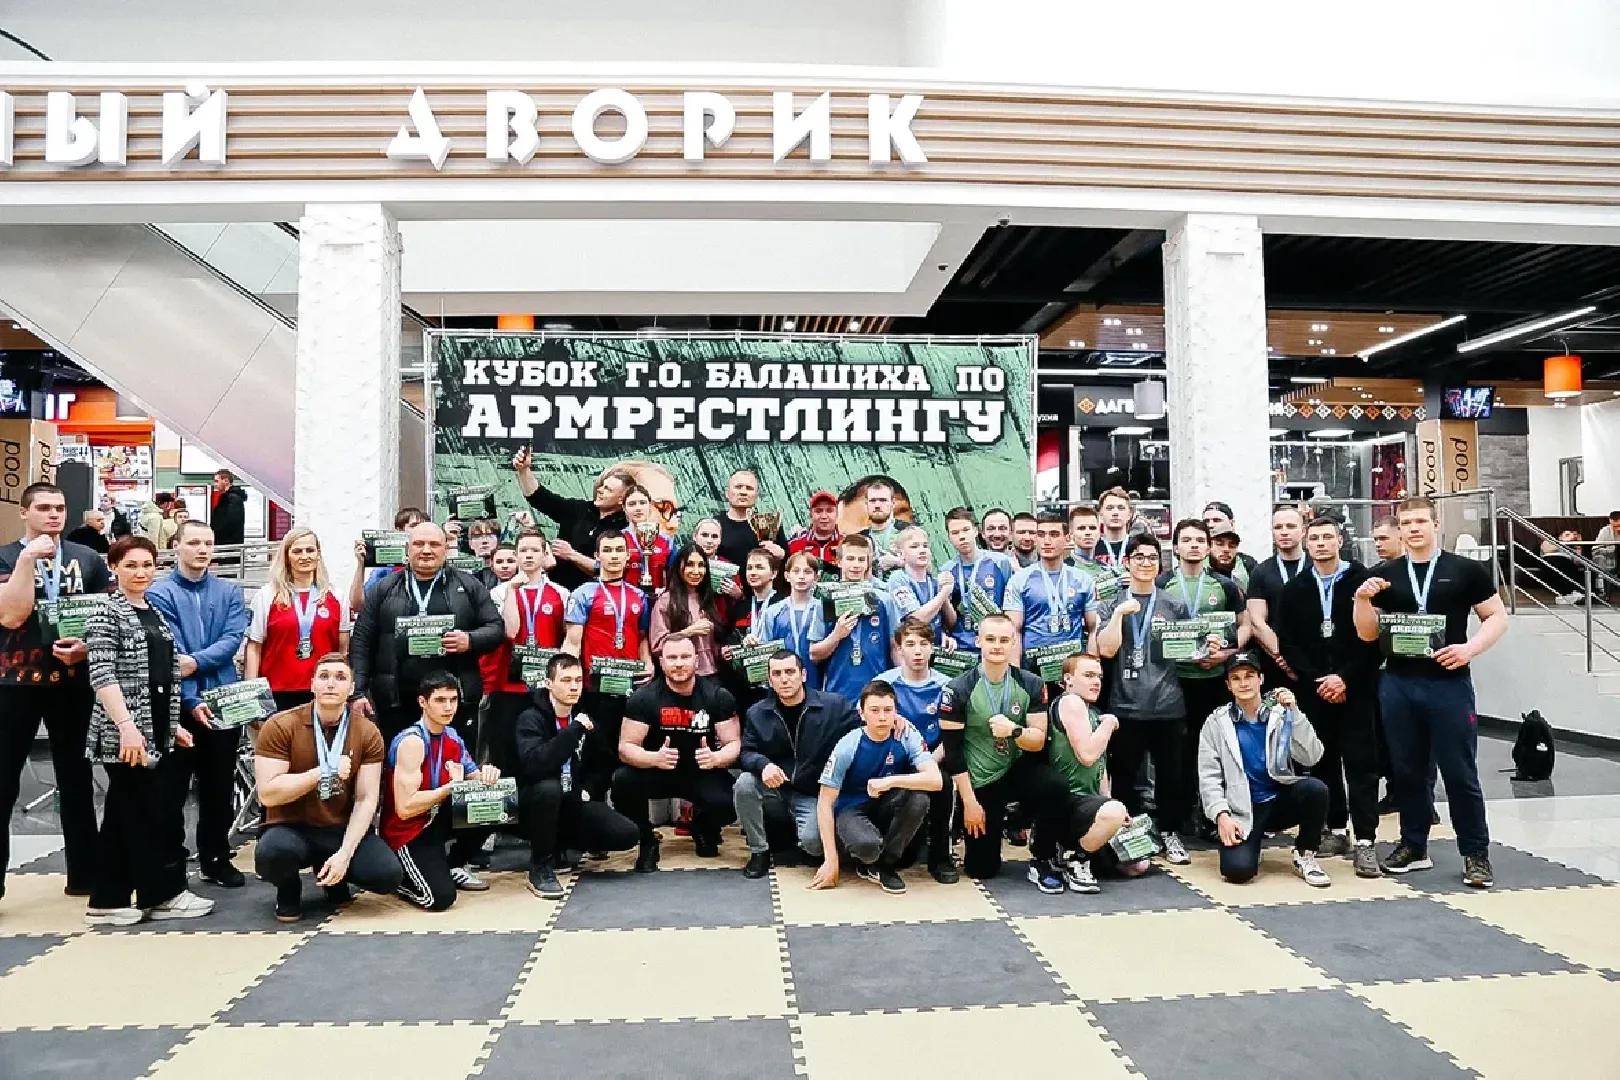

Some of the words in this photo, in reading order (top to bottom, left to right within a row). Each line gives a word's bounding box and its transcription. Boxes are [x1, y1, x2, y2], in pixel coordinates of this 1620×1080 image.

[0, 84, 228, 166] ЫЙ
[386, 85, 928, 171] ДВОРИК
[462, 359, 599, 388] КУБОК
[625, 361, 692, 389] Г.О.
[705, 363, 930, 391] БАЛАШИХА
[956, 366, 1004, 393] ПО
[461, 394, 1005, 443] АРМРЕСТЛИНГУ
[0, 440, 21, 504] Food
[38, 441, 51, 484] ood
[1450, 437, 1469, 494] Food
